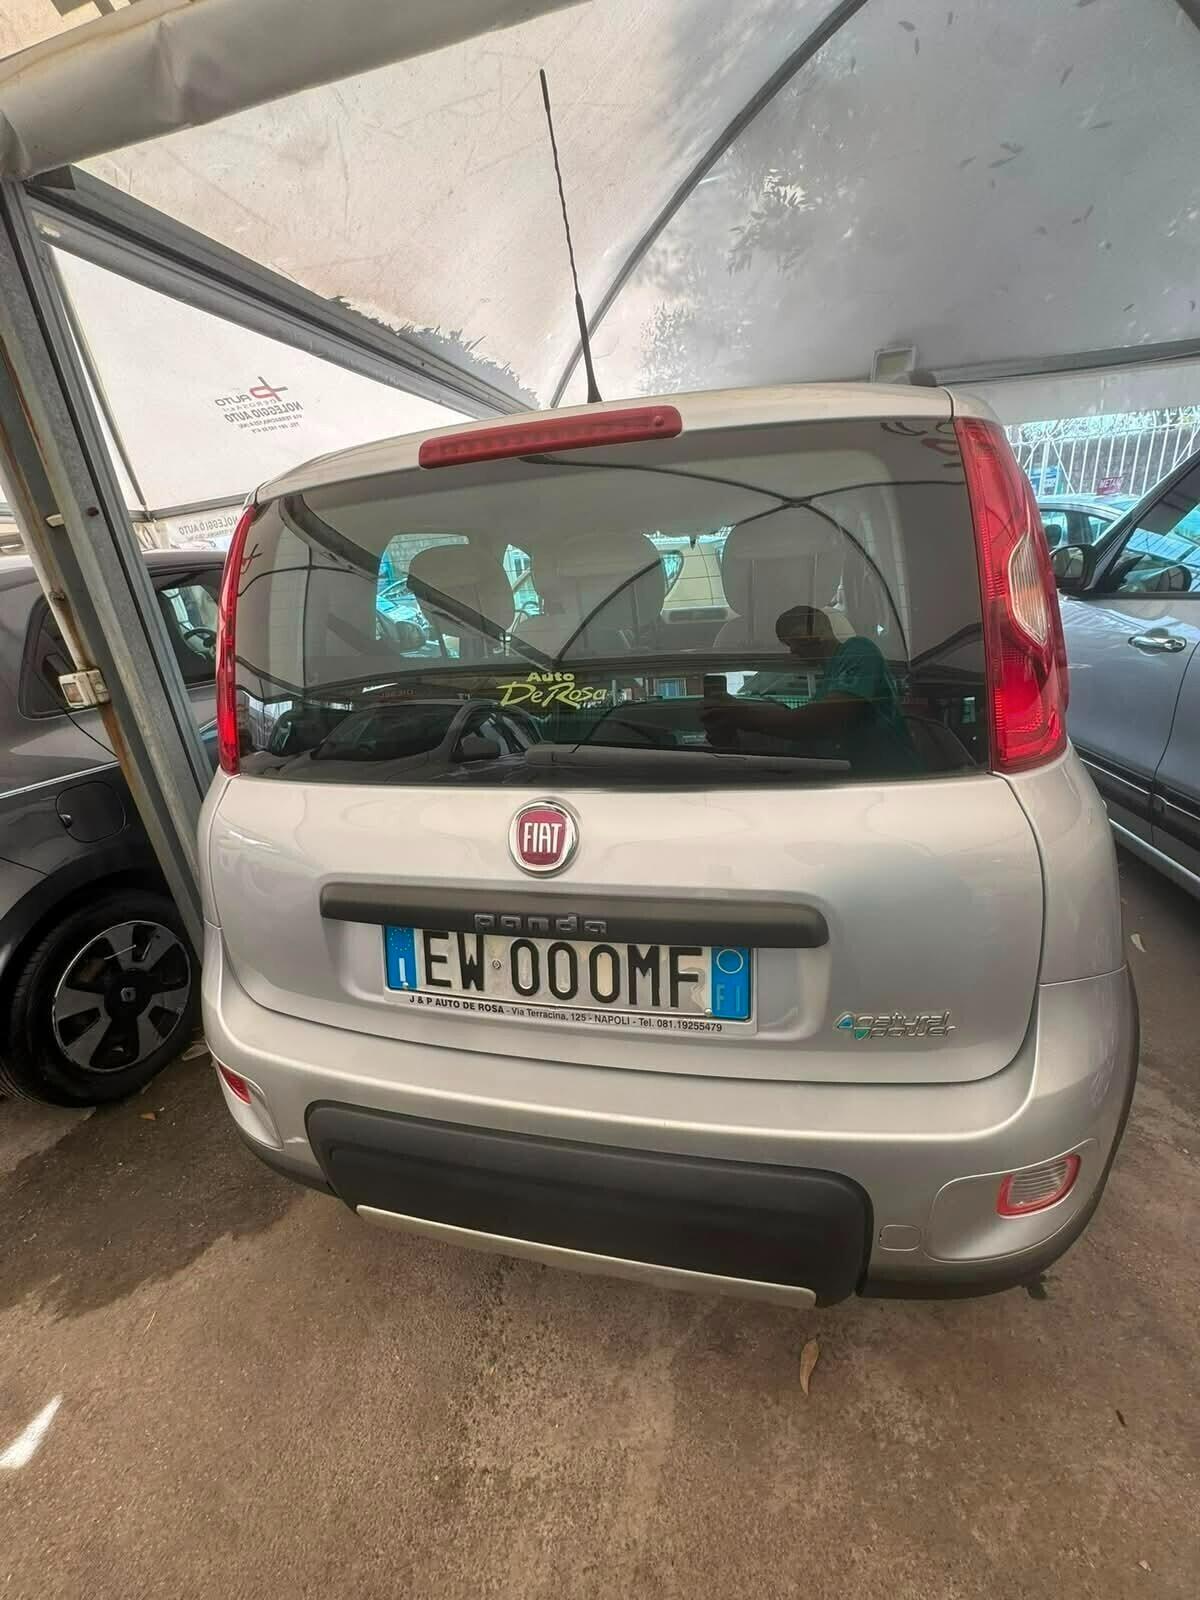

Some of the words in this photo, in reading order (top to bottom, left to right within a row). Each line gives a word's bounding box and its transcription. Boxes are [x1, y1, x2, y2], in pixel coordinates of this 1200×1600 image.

[526, 672, 575, 682] Auto
[523, 822, 562, 853] FIAT
[399, 957, 407, 982] I
[422, 930, 485, 992] EW
[716, 984, 741, 1012] FI
[435, 998, 461, 1010] AUTO
[462, 1001, 476, 1011] DE
[478, 1002, 505, 1014] ROSA
[511, 1007, 525, 1016] Via
[526, 1008, 569, 1021] Terracina,
[571, 1013, 587, 1022] 125
[594, 1014, 631, 1026] NAPOLI
[638, 1017, 655, 1028] Tel.
[657, 1019, 723, 1033] 081.19255479
